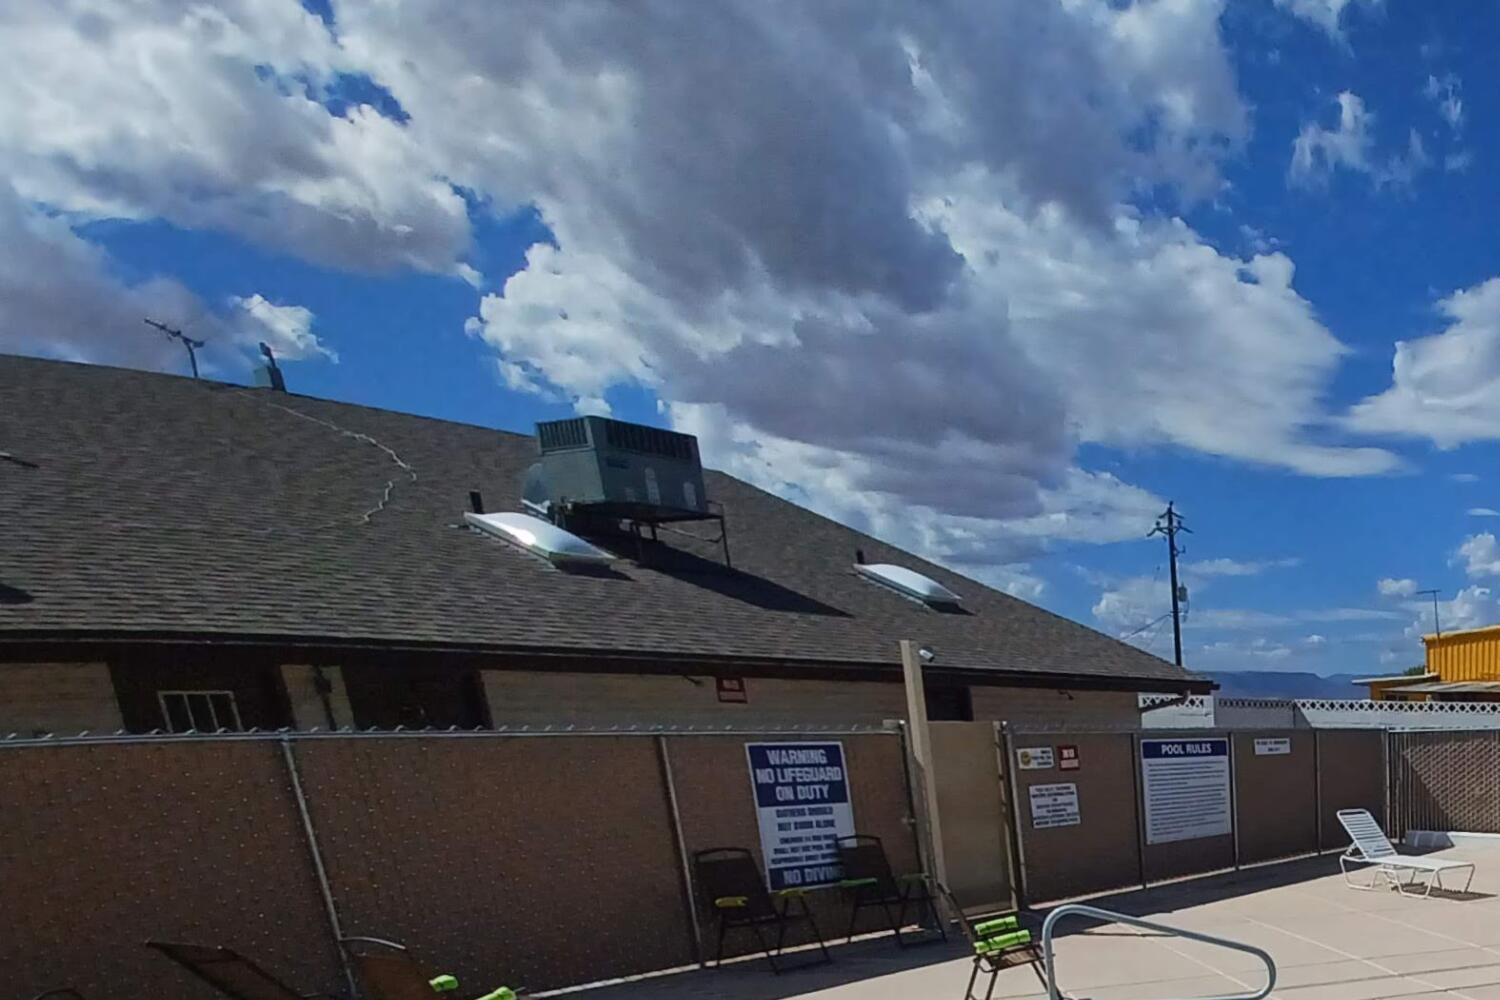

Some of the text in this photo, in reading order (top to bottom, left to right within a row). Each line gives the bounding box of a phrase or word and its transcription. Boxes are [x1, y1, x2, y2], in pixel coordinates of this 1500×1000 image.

[1161, 743, 1212, 755] POOL RULES
[767, 750, 827, 765] WARNING
[756, 767, 842, 784] NO LIFEGUARD
[776, 785, 830, 801] ON DUTY
[783, 866, 843, 885] NO DIVIN
